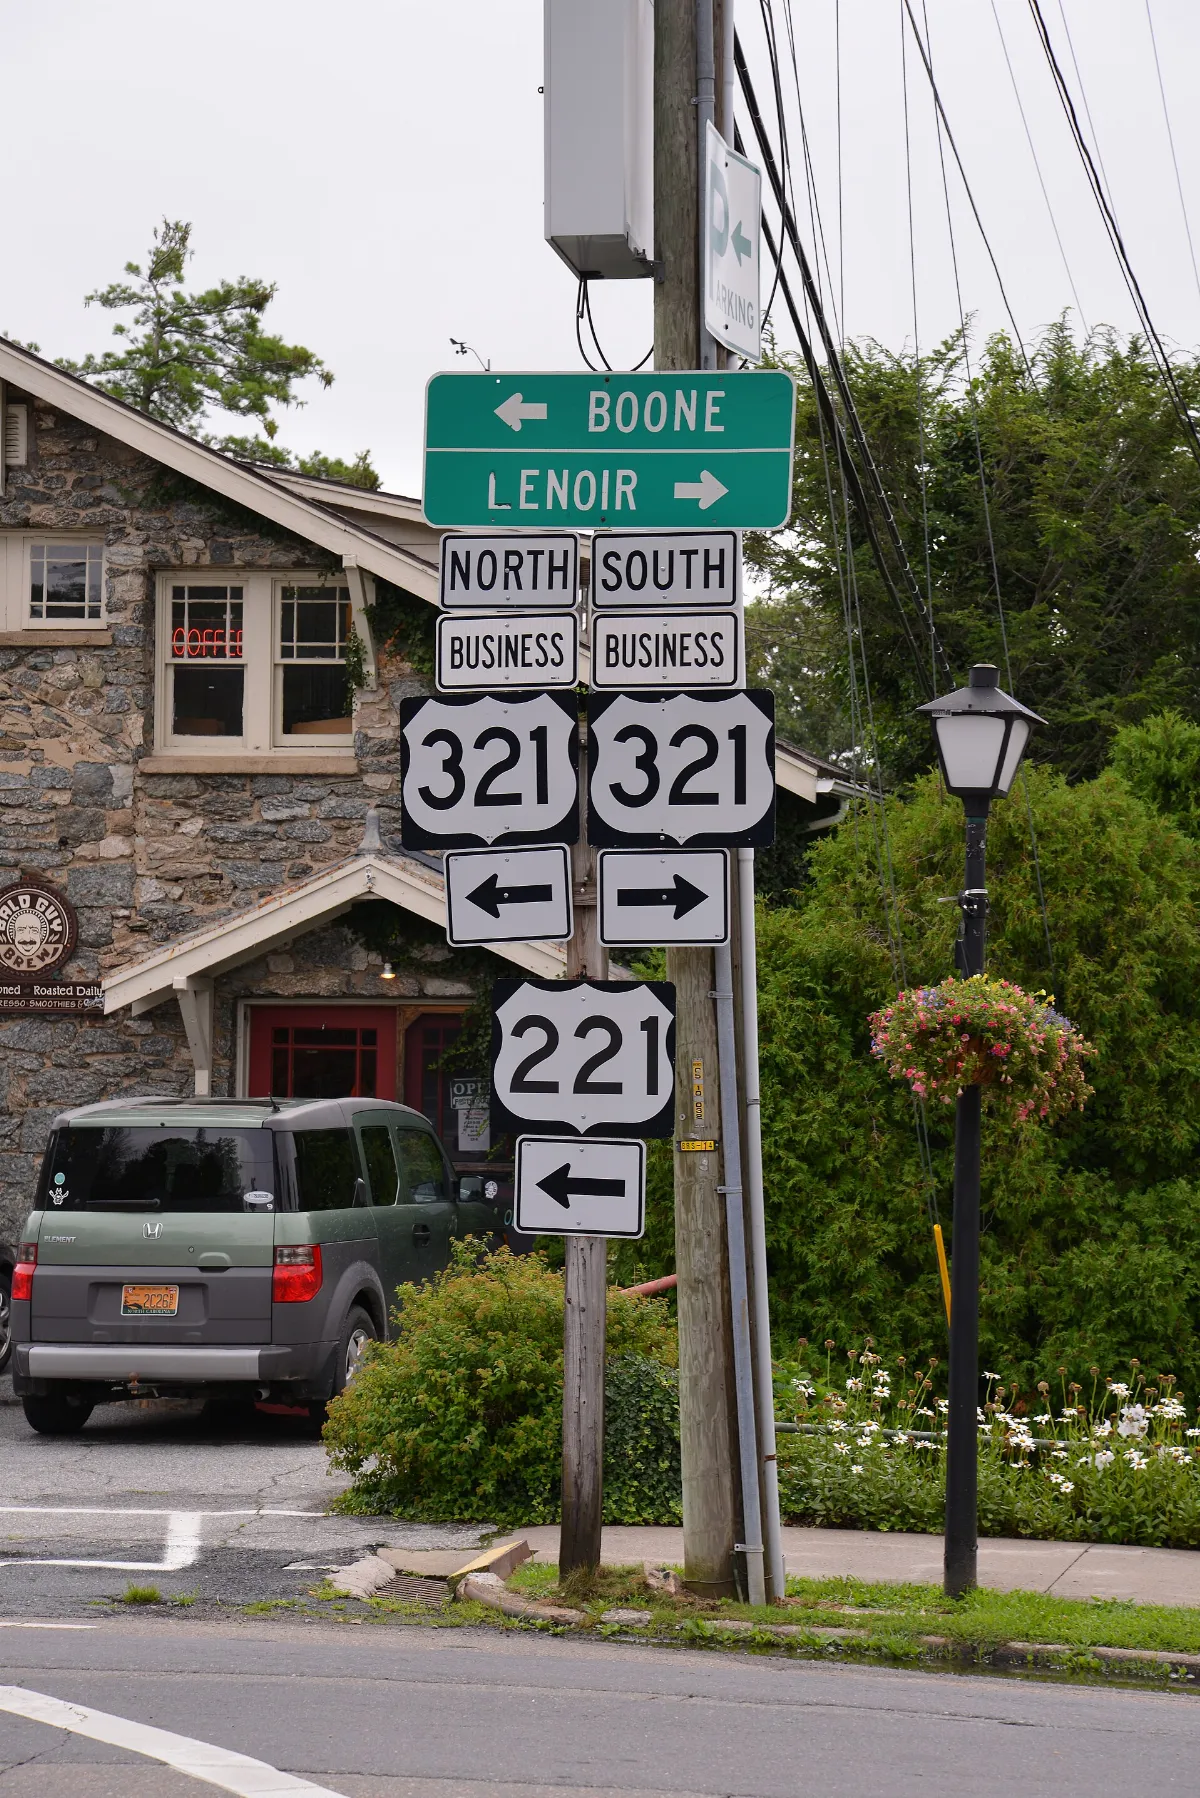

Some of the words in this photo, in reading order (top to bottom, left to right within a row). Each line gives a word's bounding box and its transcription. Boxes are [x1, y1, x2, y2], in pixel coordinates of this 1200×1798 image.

[588, 390, 726, 433] BOONE
[488, 469, 638, 511] LENOIR
[450, 549, 569, 591] NORTH
[601, 548, 725, 592] SOUTH
[450, 632, 564, 670] BUSINESS
[605, 631, 724, 668] BUSINESS
[418, 725, 549, 811] 321
[609, 724, 747, 808] 321
[35, 897, 63, 932] GUY
[29, 999, 76, 1008] SMOOTHIES
[33, 985, 73, 996] Roasted
[509, 1014, 659, 1096] 221
[44, 1235, 76, 1243] ELEMENT
